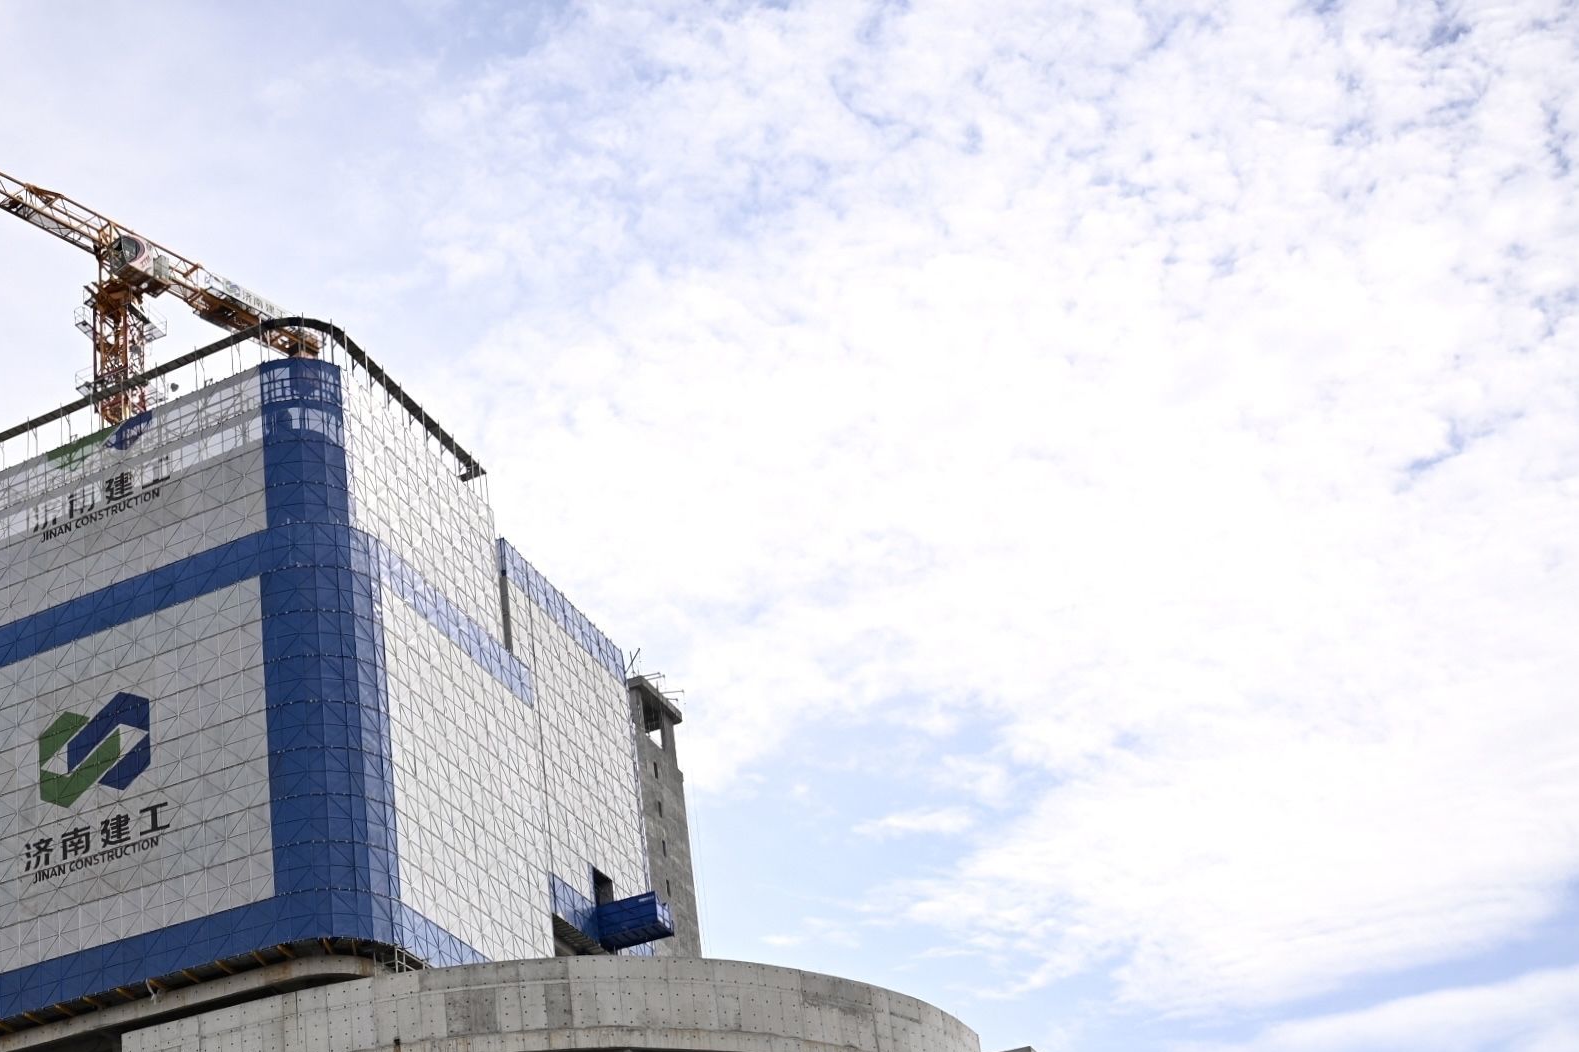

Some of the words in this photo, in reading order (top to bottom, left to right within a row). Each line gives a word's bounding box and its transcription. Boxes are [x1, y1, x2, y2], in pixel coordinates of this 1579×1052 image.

[41, 521, 72, 543] JINAN
[75, 487, 160, 529] CONSTRUCTION
[24, 801, 171, 873] 济南建工
[33, 864, 66, 885] JINAN
[68, 836, 160, 873] CONSTRUCTION
